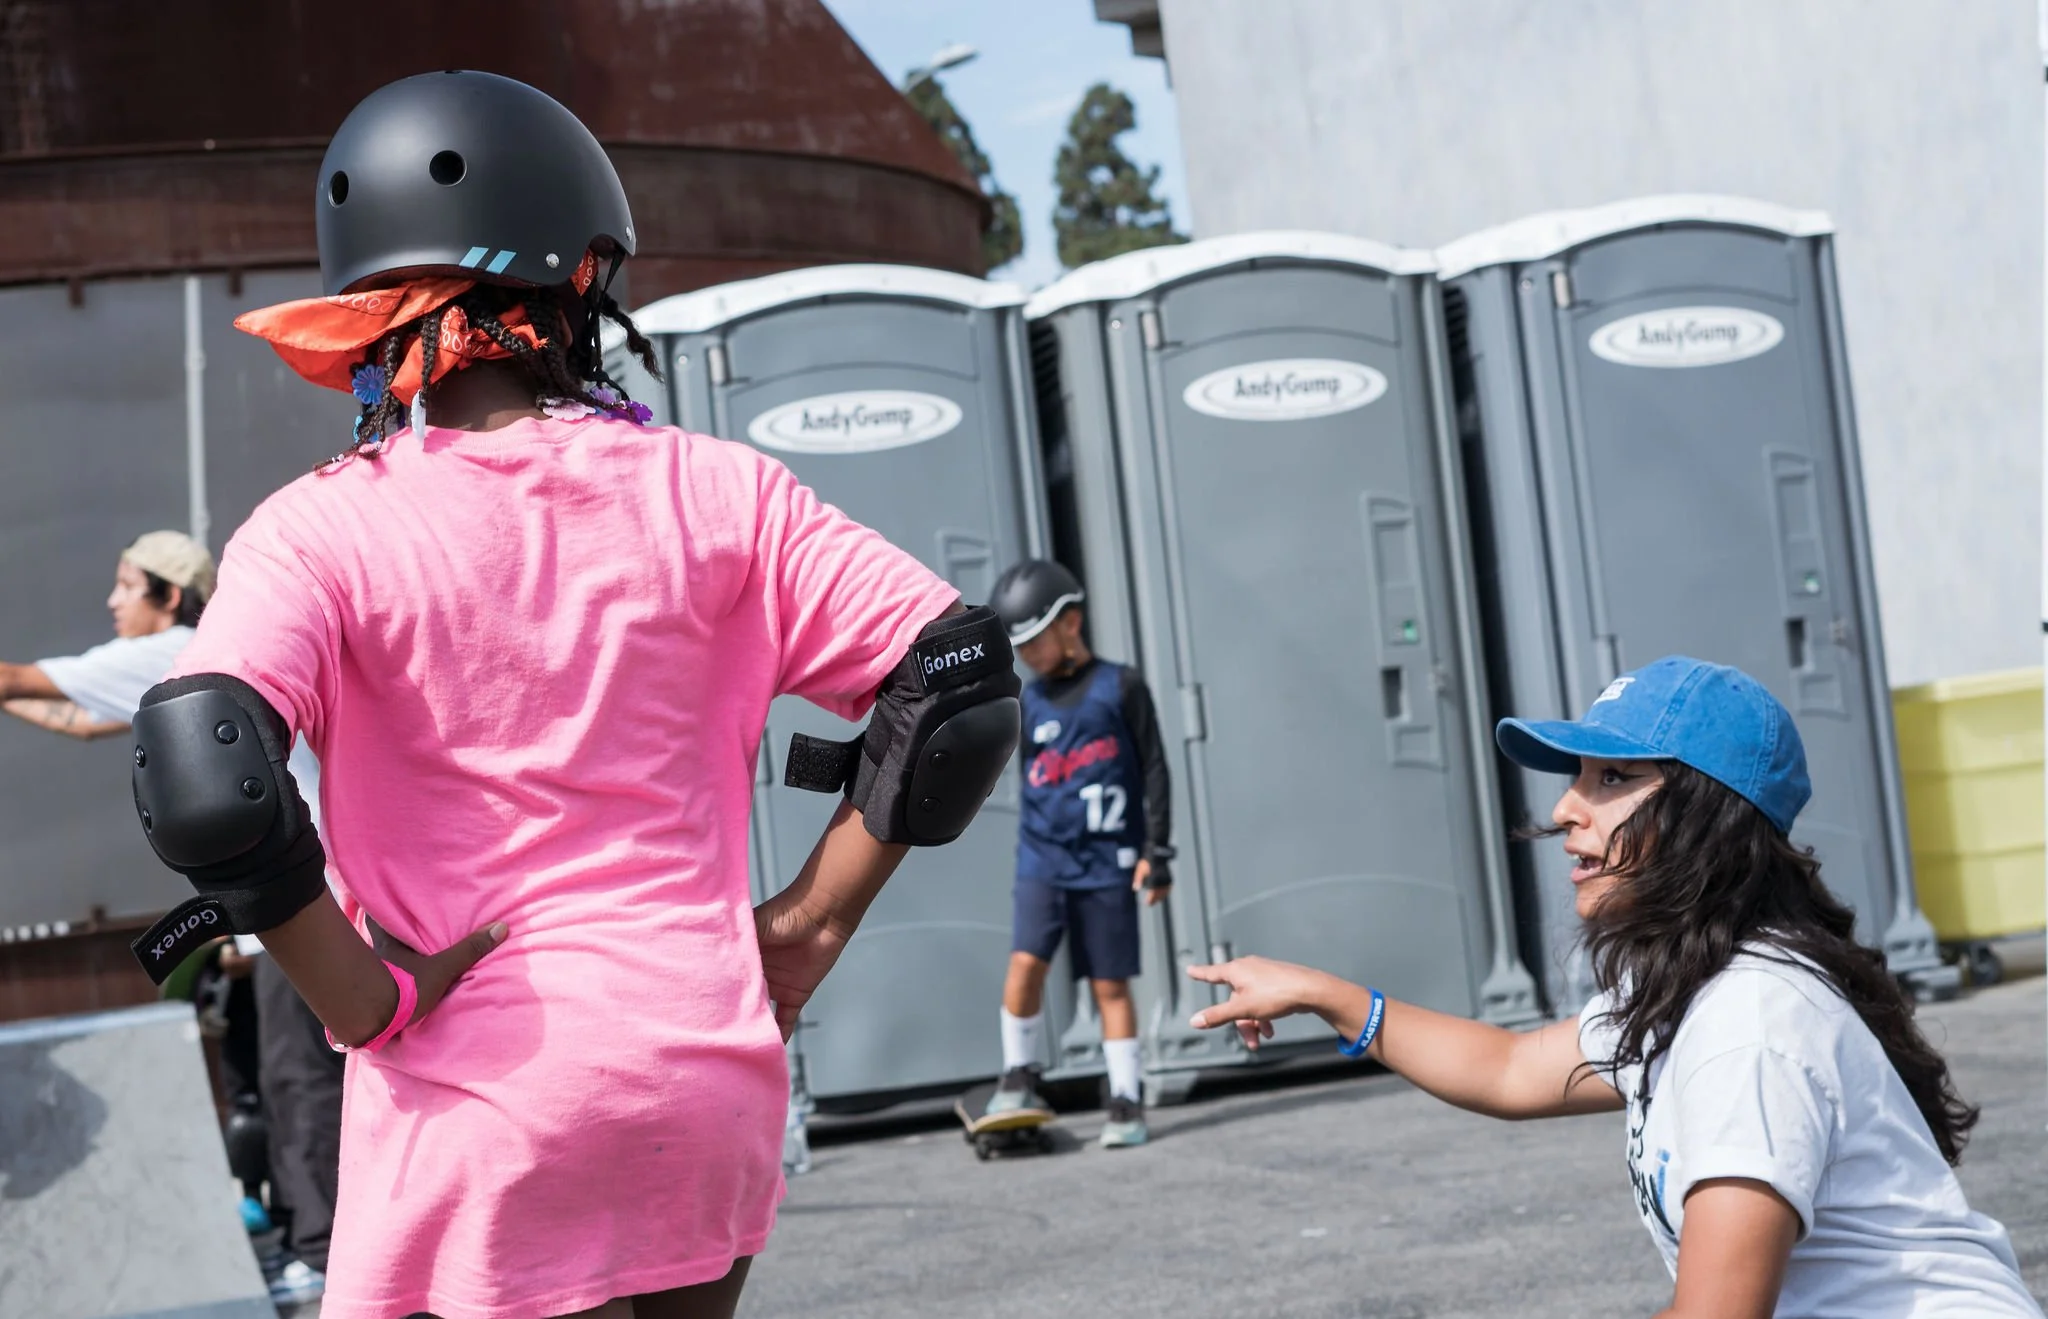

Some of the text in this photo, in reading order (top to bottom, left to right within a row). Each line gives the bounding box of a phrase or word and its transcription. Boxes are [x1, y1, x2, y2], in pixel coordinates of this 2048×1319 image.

[1233, 371, 1341, 402] AndyGump
[801, 403, 914, 435] AndyGump
[924, 643, 985, 675] Gonex
[1079, 783, 1127, 832] 12
[151, 909, 218, 960] Gonex
